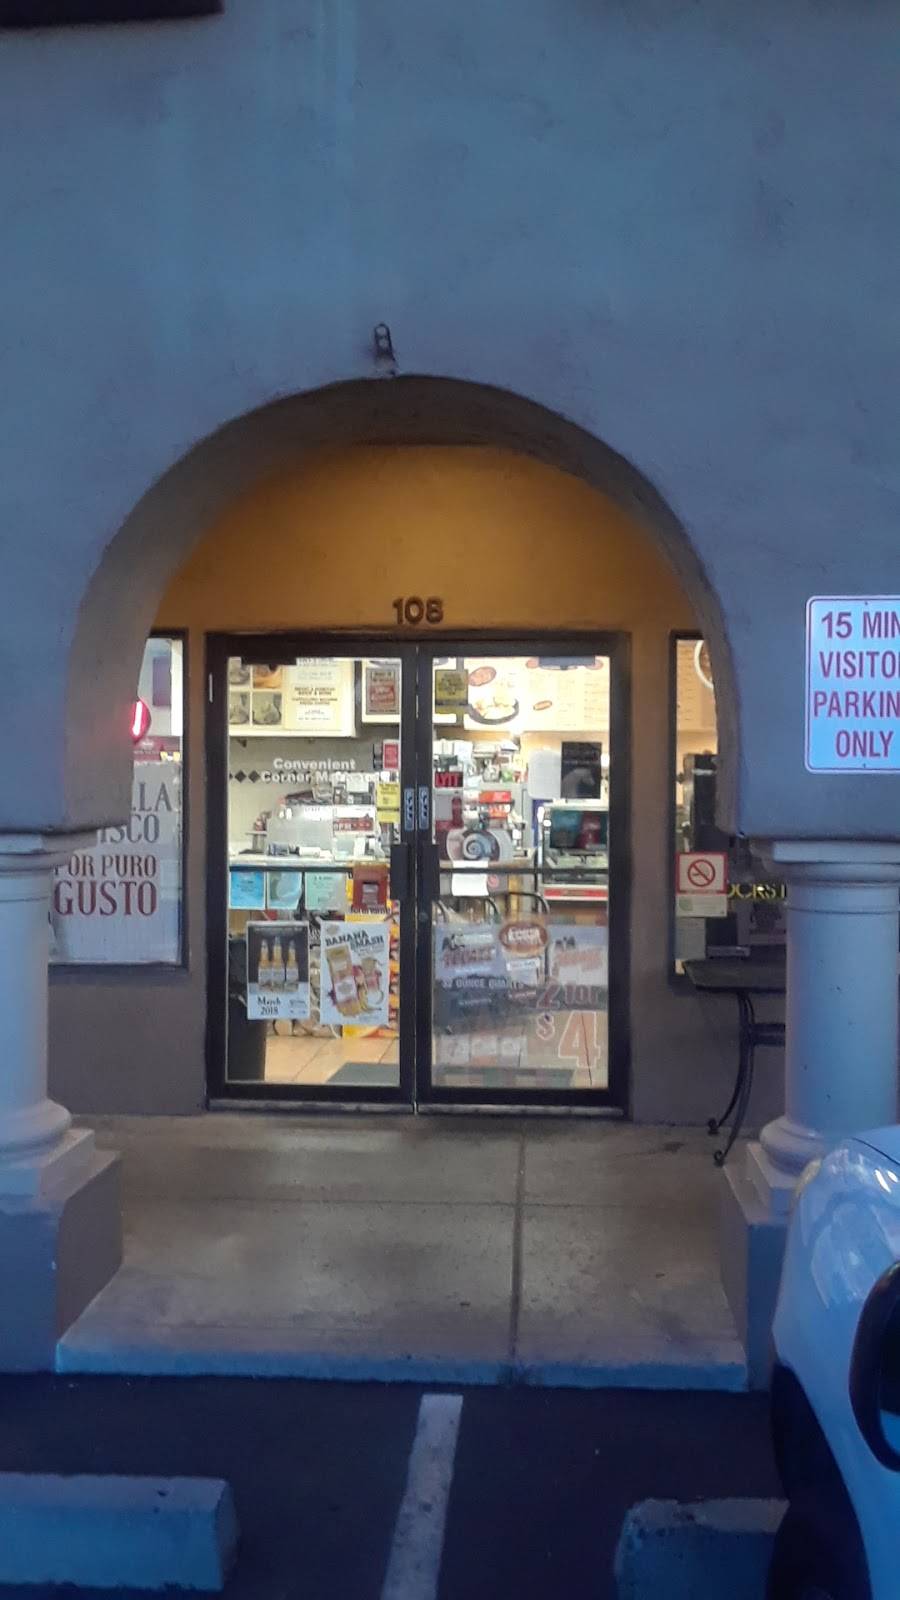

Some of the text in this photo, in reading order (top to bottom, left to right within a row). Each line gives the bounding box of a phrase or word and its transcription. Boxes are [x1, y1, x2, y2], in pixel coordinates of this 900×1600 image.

[392, 597, 443, 624] 108
[821, 611, 900, 638] 15 MIN
[819, 650, 900, 678] VISITO
[814, 690, 900, 717] PARKIN
[836, 730, 893, 758] ONLY
[273, 758, 356, 770] Convenient
[261, 771, 312, 784] Corner
[132, 782, 172, 812] LA
[102, 854, 156, 877] PURO
[54, 880, 157, 916] GUSTO
[325, 930, 368, 946] BANANA
[351, 936, 384, 950] SMASH
[257, 996, 280, 1005] March
[261, 1006, 278, 1015] 2018
